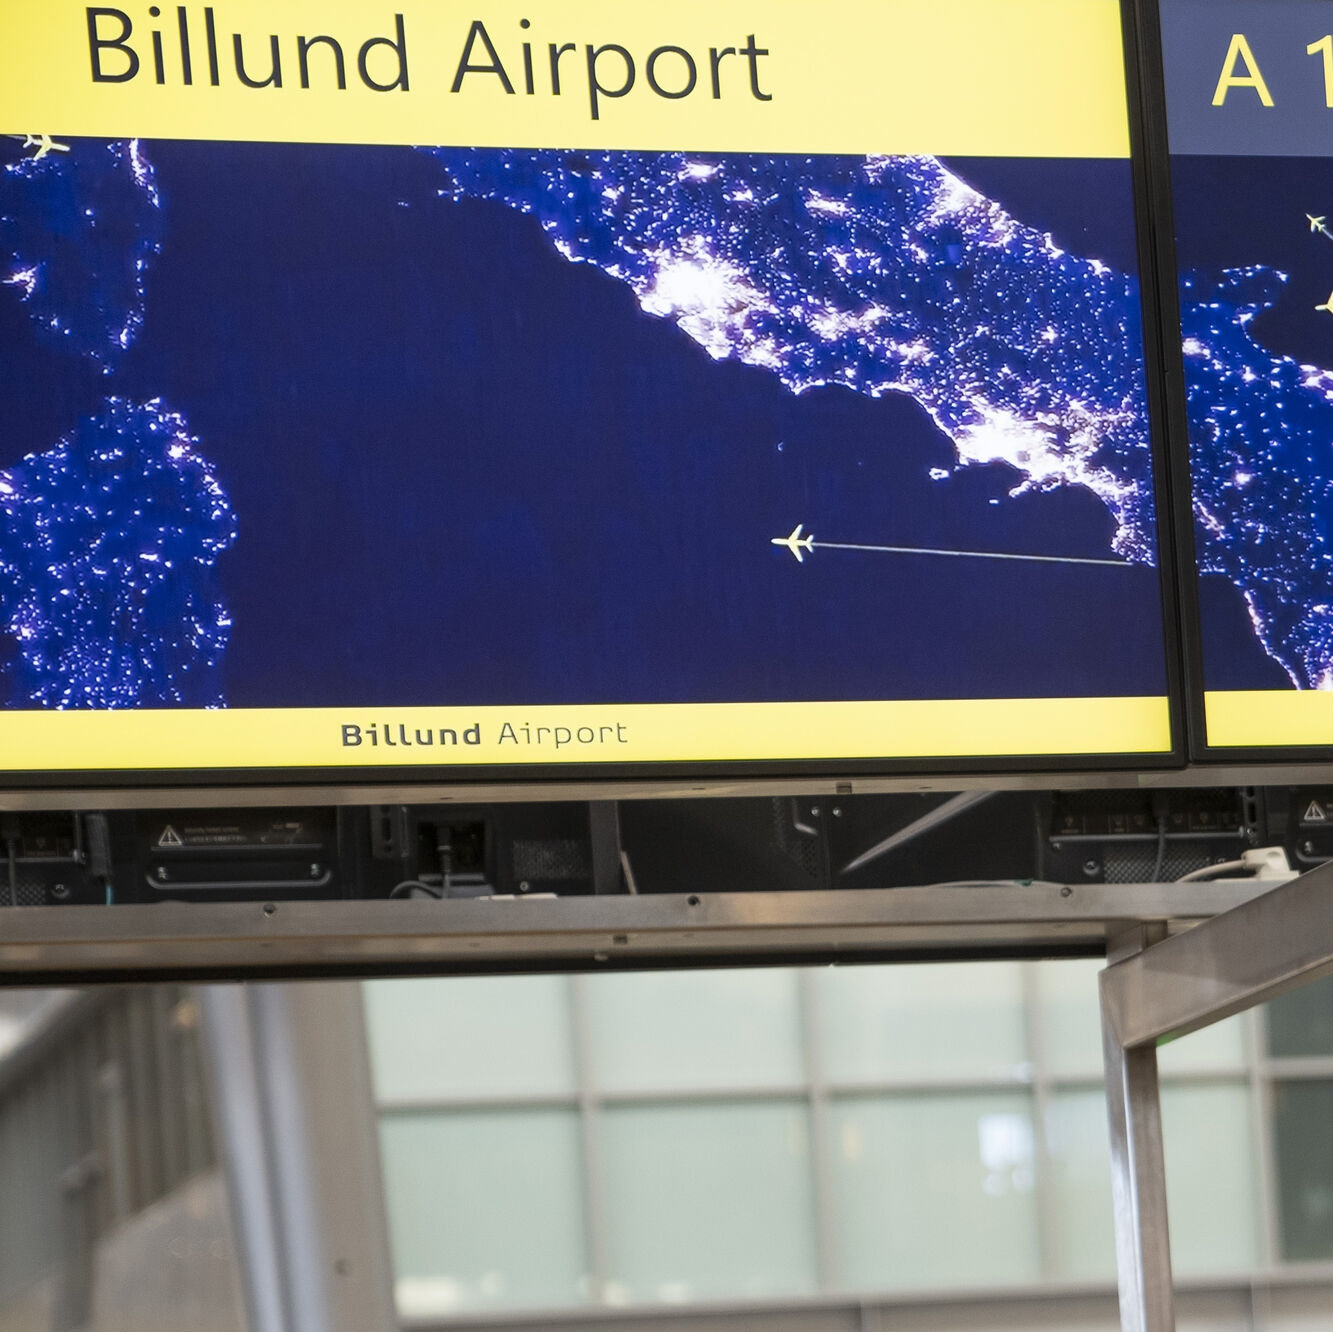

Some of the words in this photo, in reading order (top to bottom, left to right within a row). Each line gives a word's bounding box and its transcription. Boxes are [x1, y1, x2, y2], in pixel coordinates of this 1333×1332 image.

[86, 6, 409, 92] Billund
[451, 18, 773, 120] Airport
[1212, 34, 1274, 106] A
[341, 722, 481, 747] Billund
[497, 721, 628, 750] Airport
